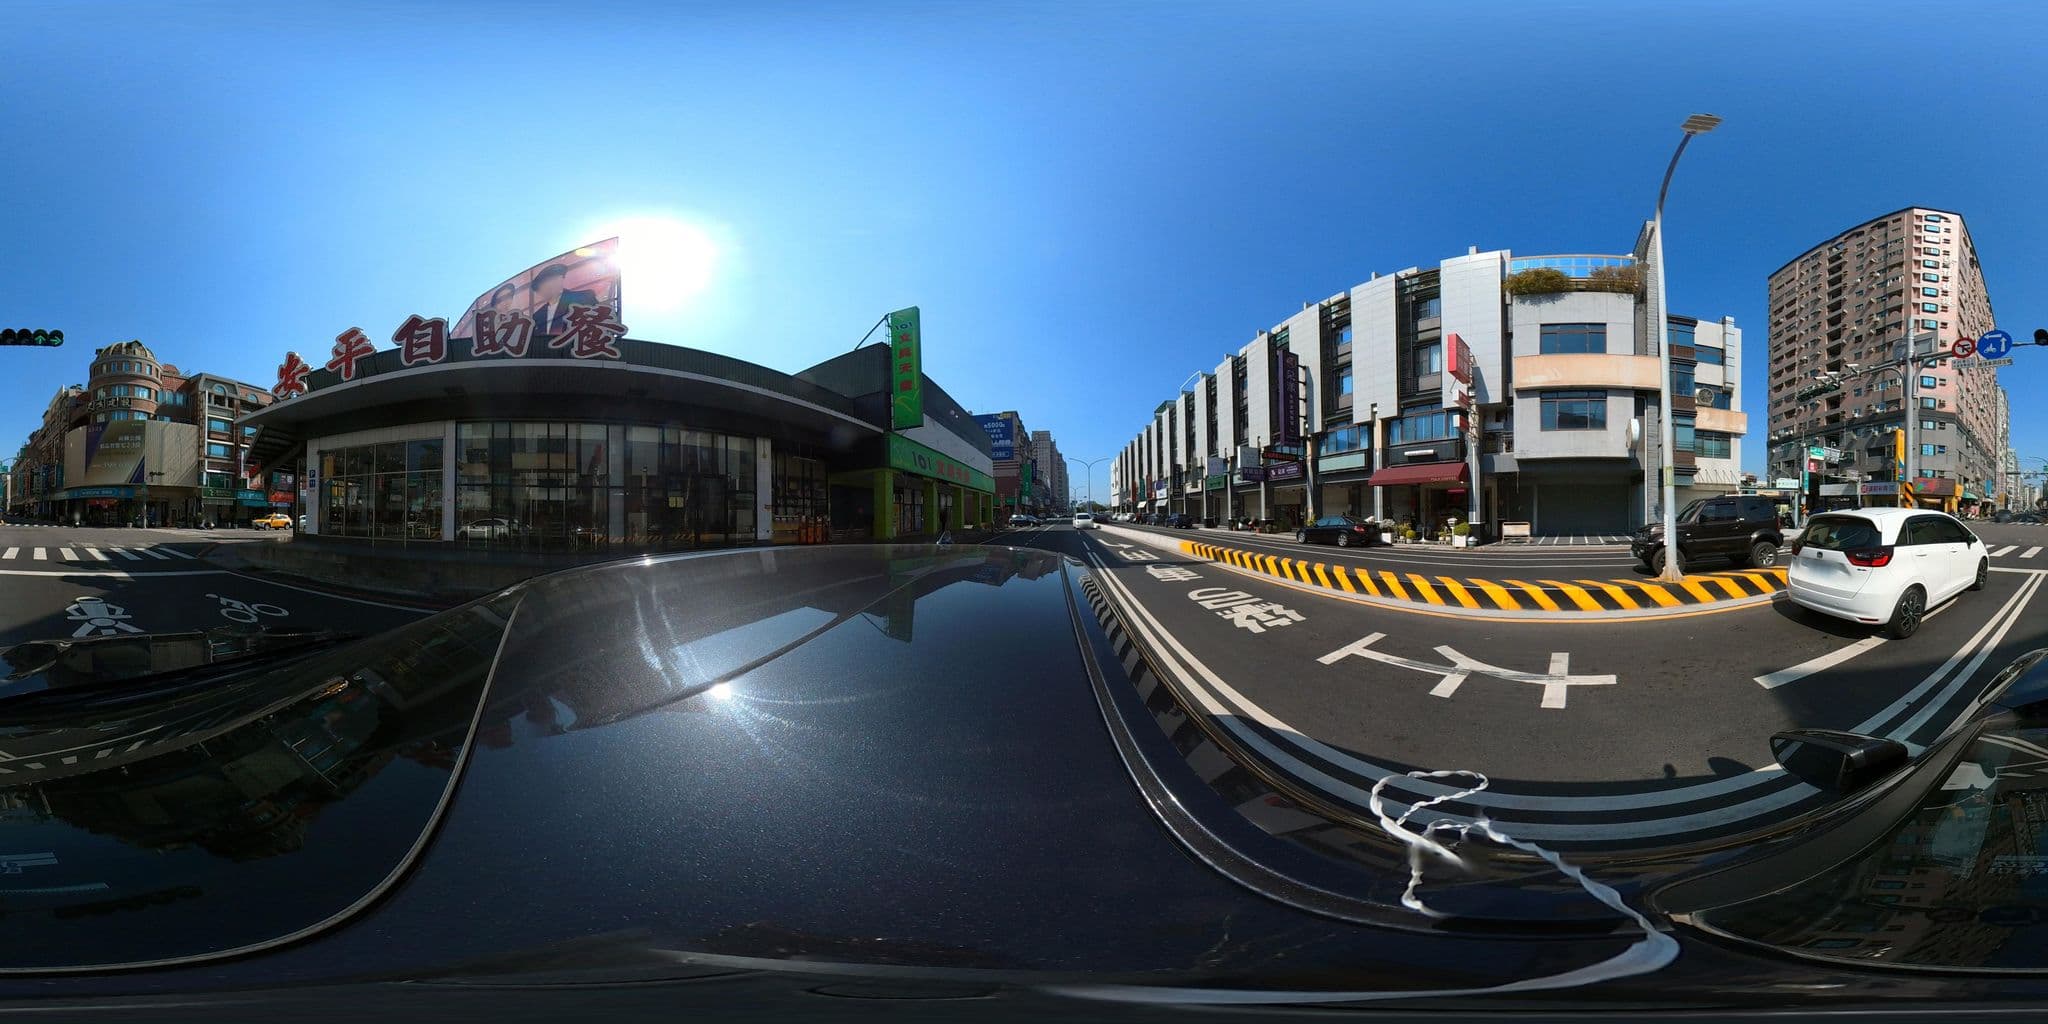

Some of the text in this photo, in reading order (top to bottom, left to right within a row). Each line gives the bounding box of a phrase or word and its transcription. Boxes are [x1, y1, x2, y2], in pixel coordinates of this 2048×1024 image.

[895, 322, 913, 331] 101
[272, 304, 628, 400] 安平自助餐
[912, 452, 932, 470] 101
